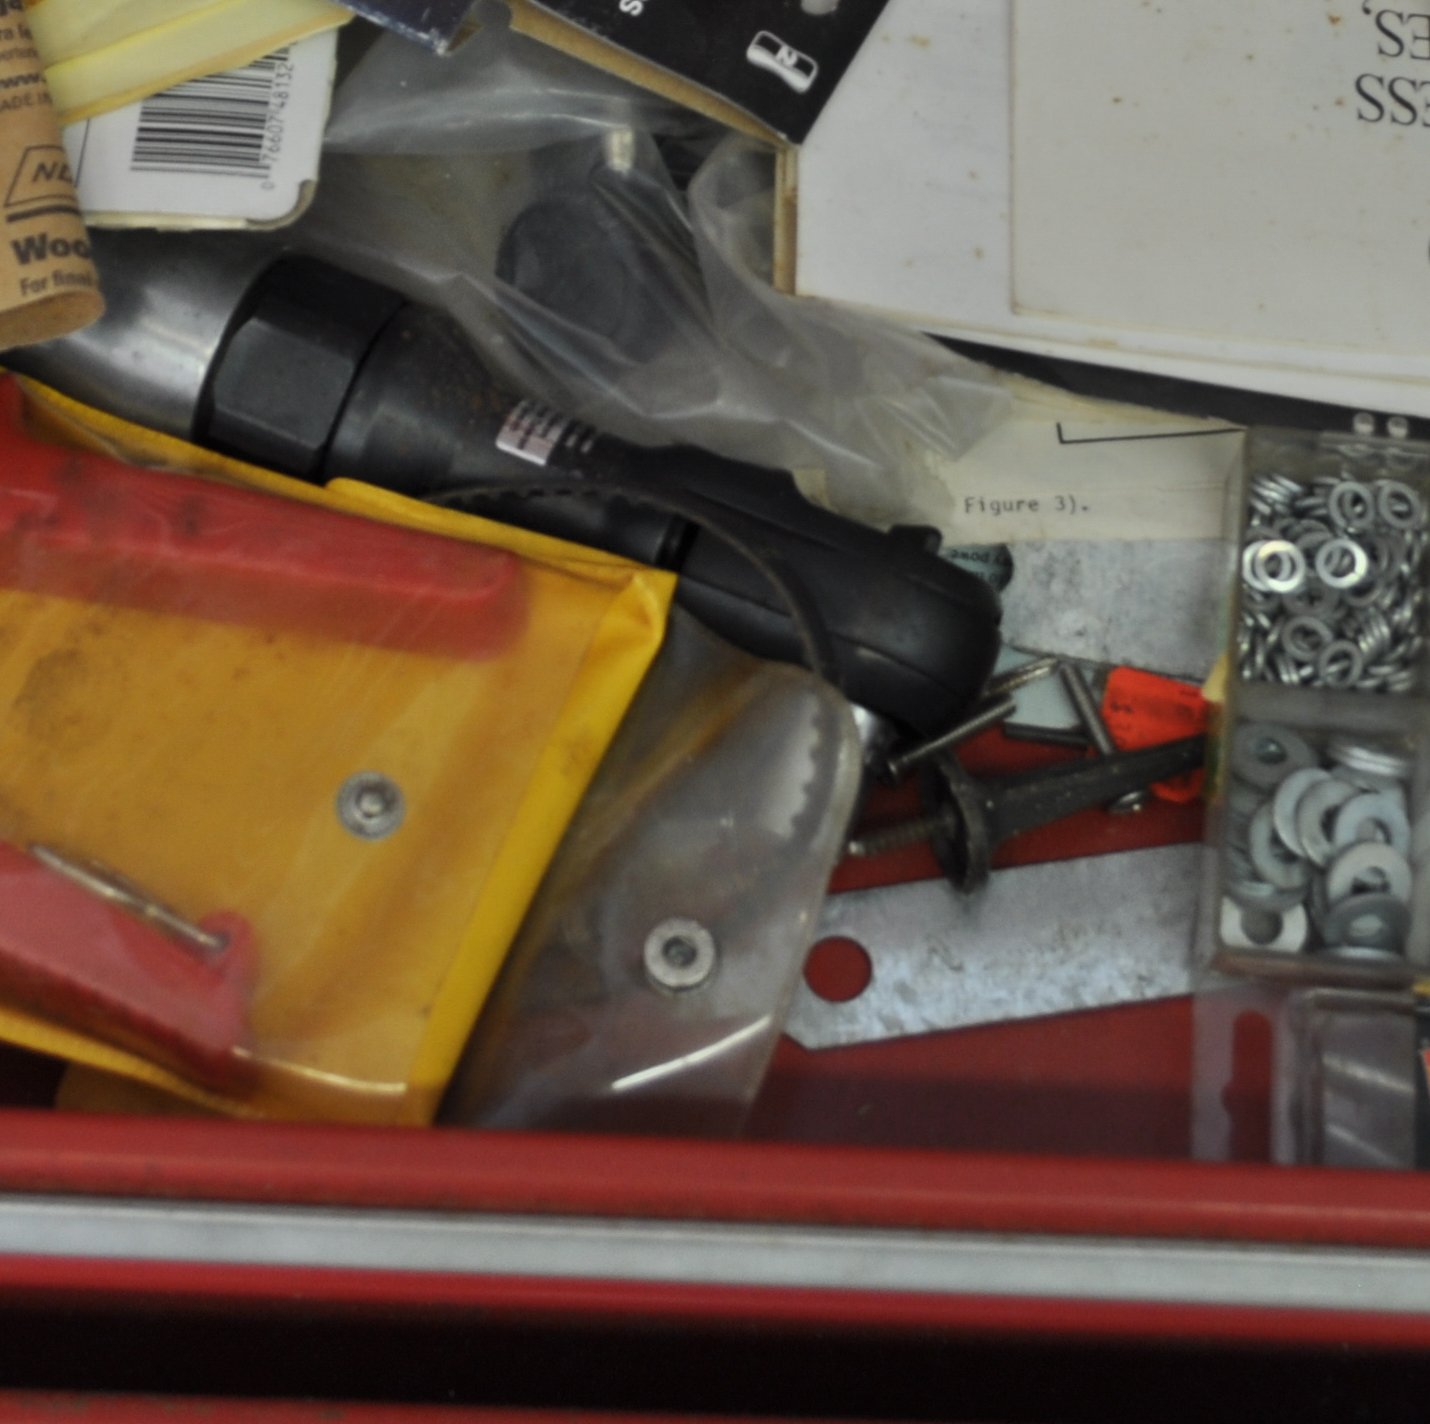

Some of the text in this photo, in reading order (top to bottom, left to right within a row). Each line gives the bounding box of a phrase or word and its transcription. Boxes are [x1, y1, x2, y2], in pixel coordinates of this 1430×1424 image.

[20, 277, 47, 296] For
[964, 494, 1091, 516] Figure 3).
